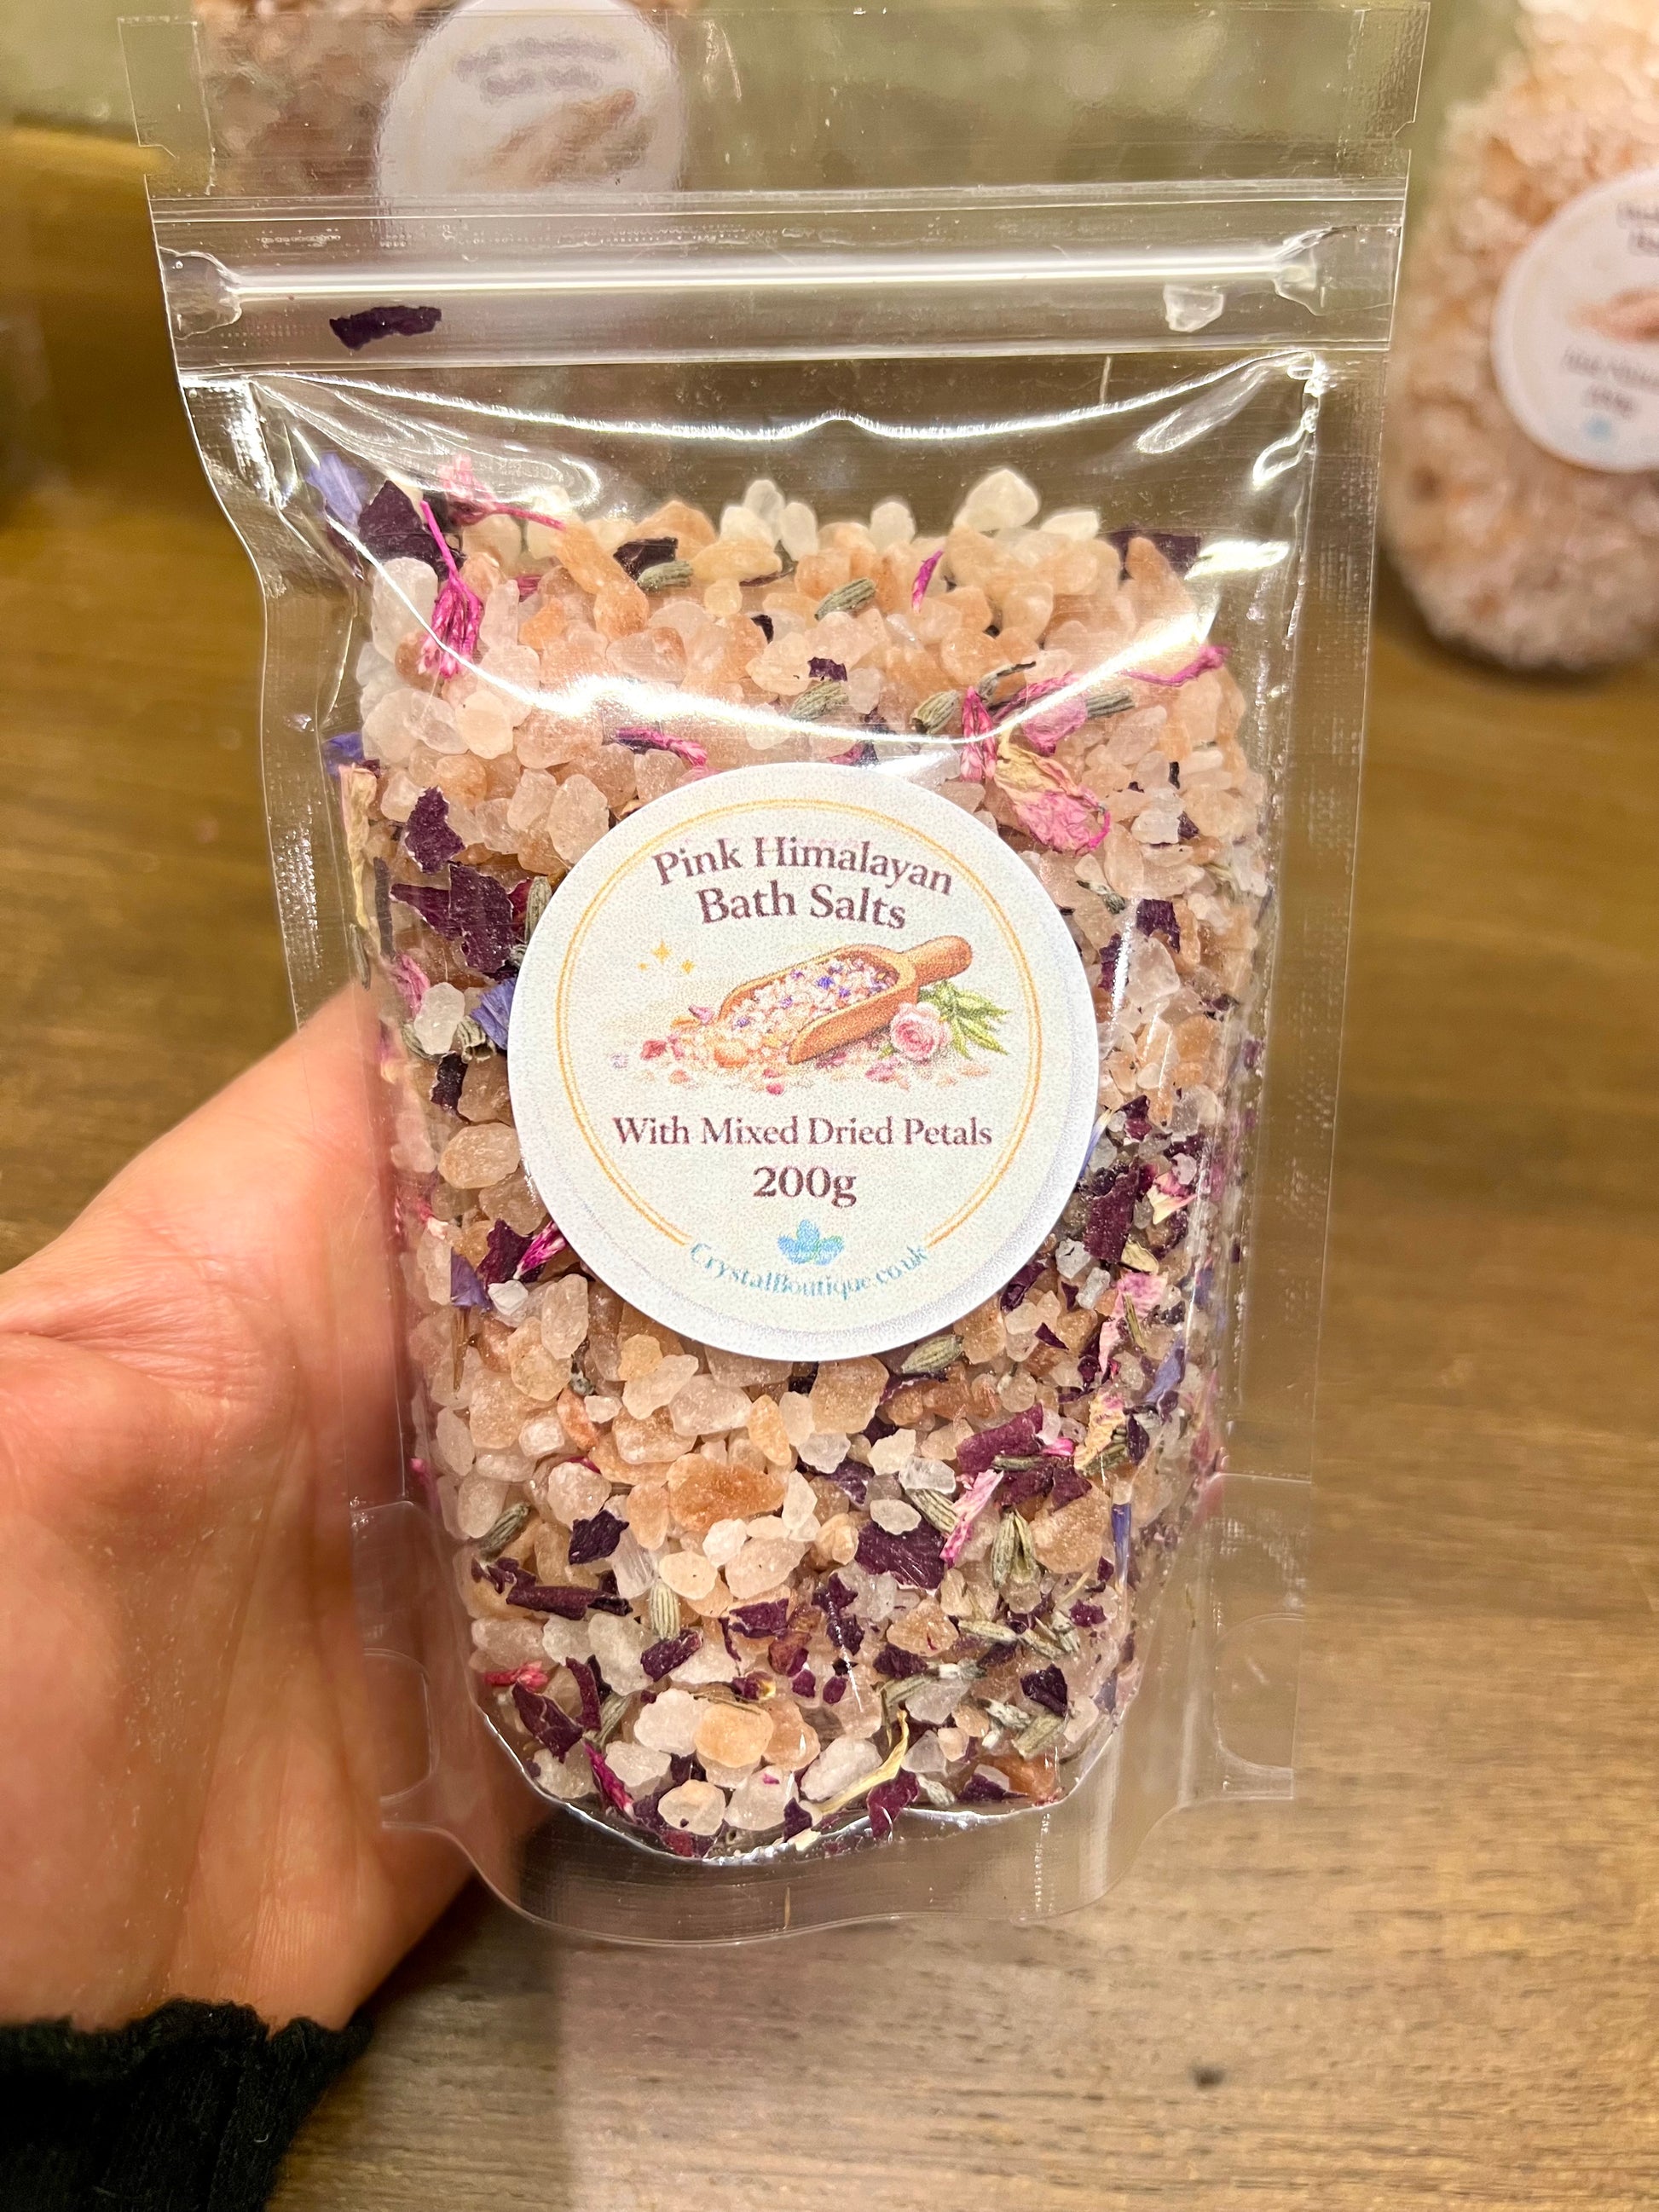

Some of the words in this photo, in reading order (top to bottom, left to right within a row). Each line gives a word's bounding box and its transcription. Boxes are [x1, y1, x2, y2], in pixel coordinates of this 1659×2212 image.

[654, 839, 743, 885] Pink
[754, 836, 953, 897] Himalayan
[696, 880, 796, 925] Bath
[810, 884, 907, 930] Salts
[613, 1115, 691, 1145] With
[701, 1115, 799, 1145] Mixed
[808, 1115, 894, 1145] Dried
[904, 1115, 993, 1146] Petals
[753, 1165, 858, 1209] 200g
[690, 1240, 929, 1301] CrystalBoutique.co.uk
